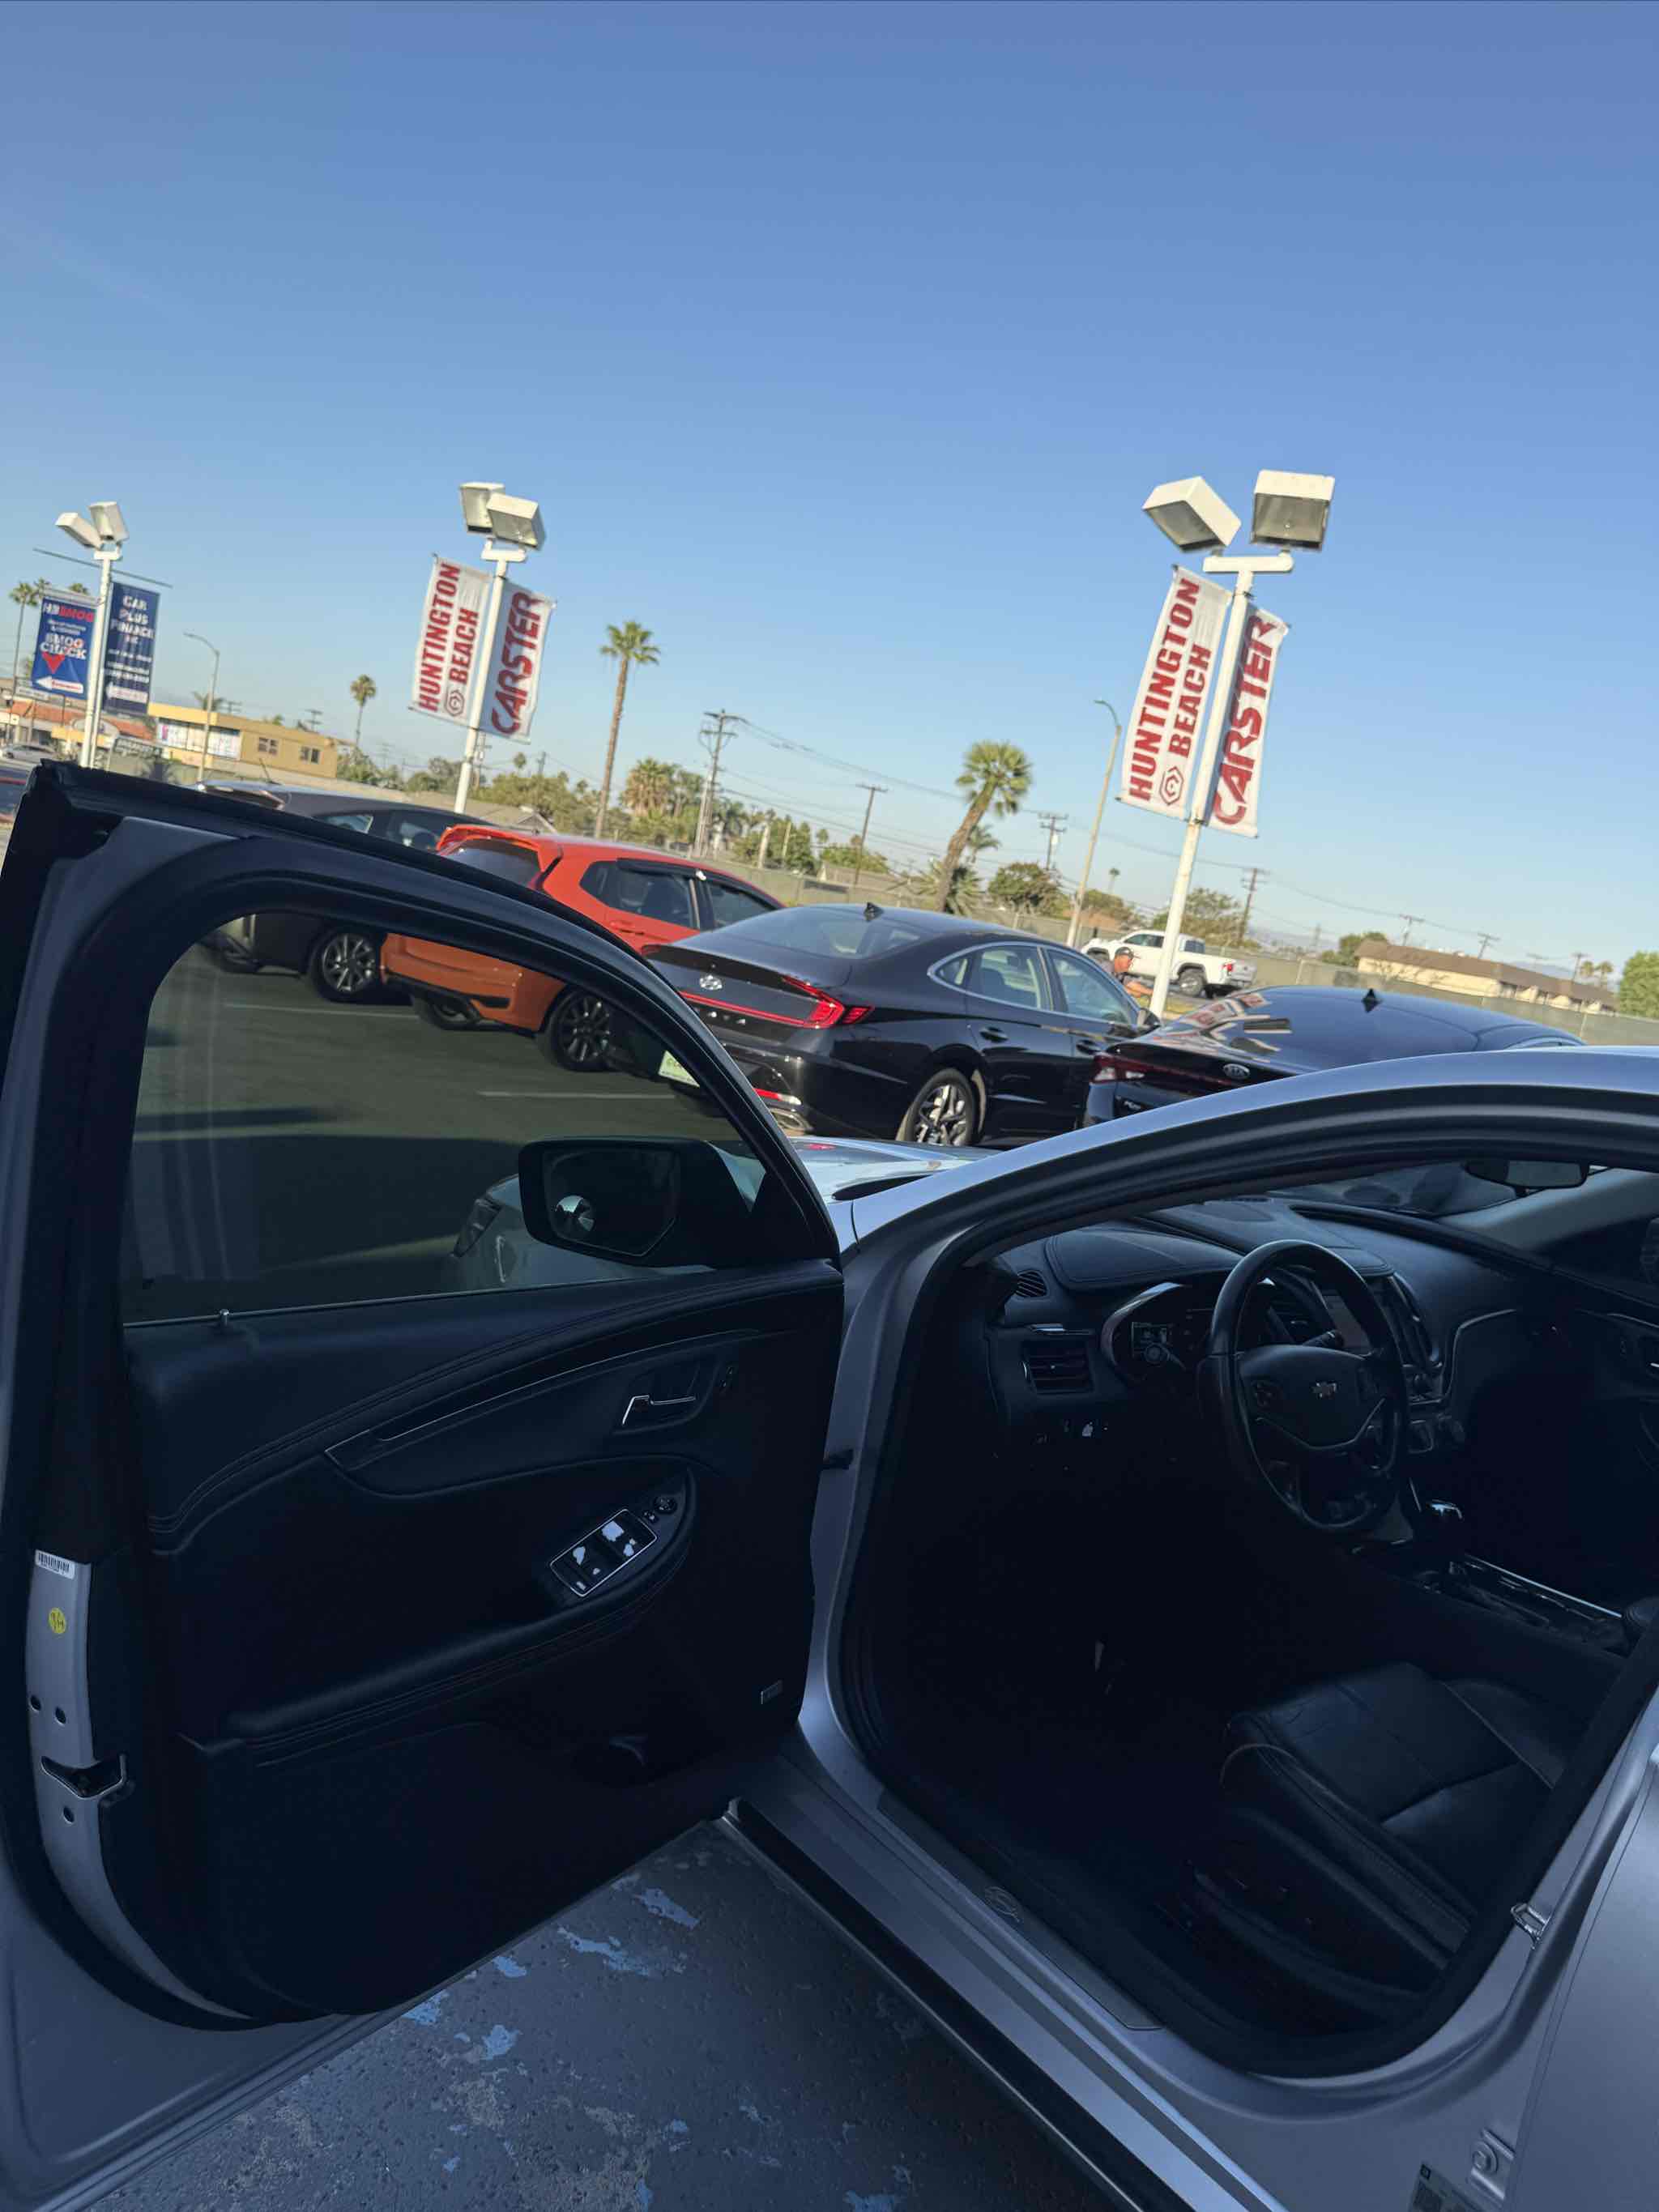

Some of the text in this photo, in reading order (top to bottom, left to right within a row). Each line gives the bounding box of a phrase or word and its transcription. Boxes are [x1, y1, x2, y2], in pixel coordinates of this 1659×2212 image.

[419, 564, 461, 712] HUNTINGTON
[448, 608, 480, 685] BEACH
[491, 592, 544, 735] CARSTER
[1129, 578, 1200, 801] HUNTINGTON
[1169, 645, 1212, 758] BEACH
[1214, 615, 1277, 825] CARSTER
